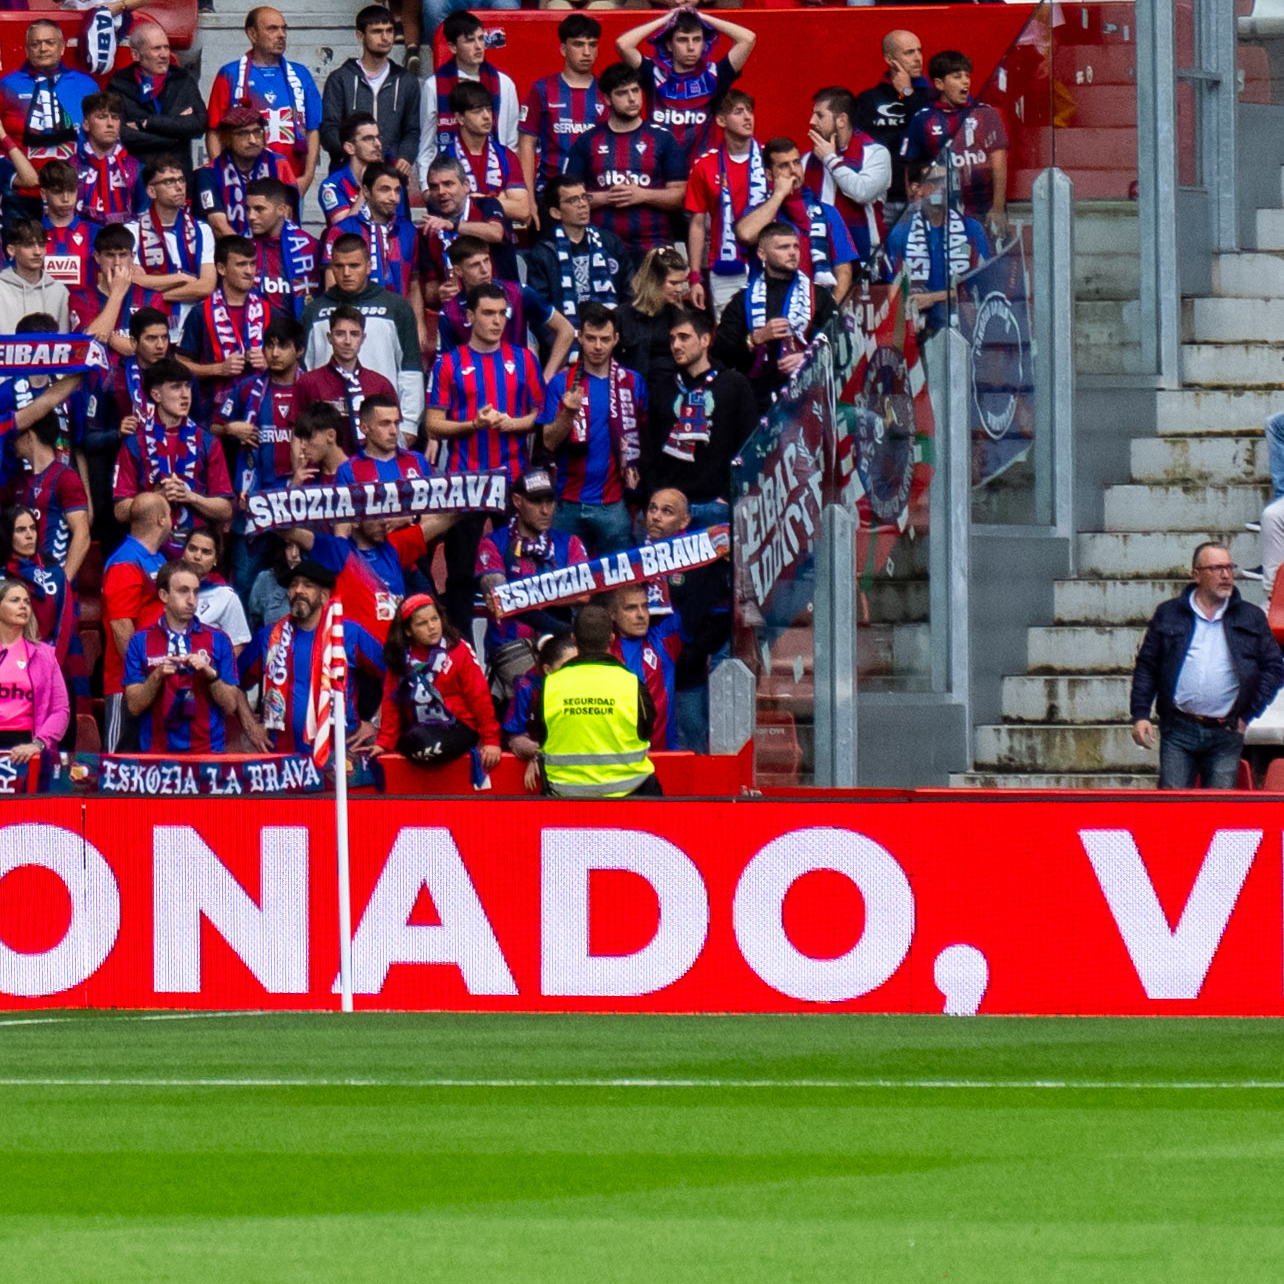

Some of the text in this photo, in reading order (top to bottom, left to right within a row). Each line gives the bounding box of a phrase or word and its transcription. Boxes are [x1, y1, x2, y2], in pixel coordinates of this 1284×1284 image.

[653, 108, 707, 126] eibho
[363, 480, 402, 517] LA
[410, 474, 508, 512] BRAVA
[497, 530, 717, 613] ESKOZIA LA BRAVA
[562, 697, 616, 708] SEGURIDAD
[562, 706, 615, 717] PROSEGUR
[100, 754, 323, 797] ESKOZIA LA BRAVA
